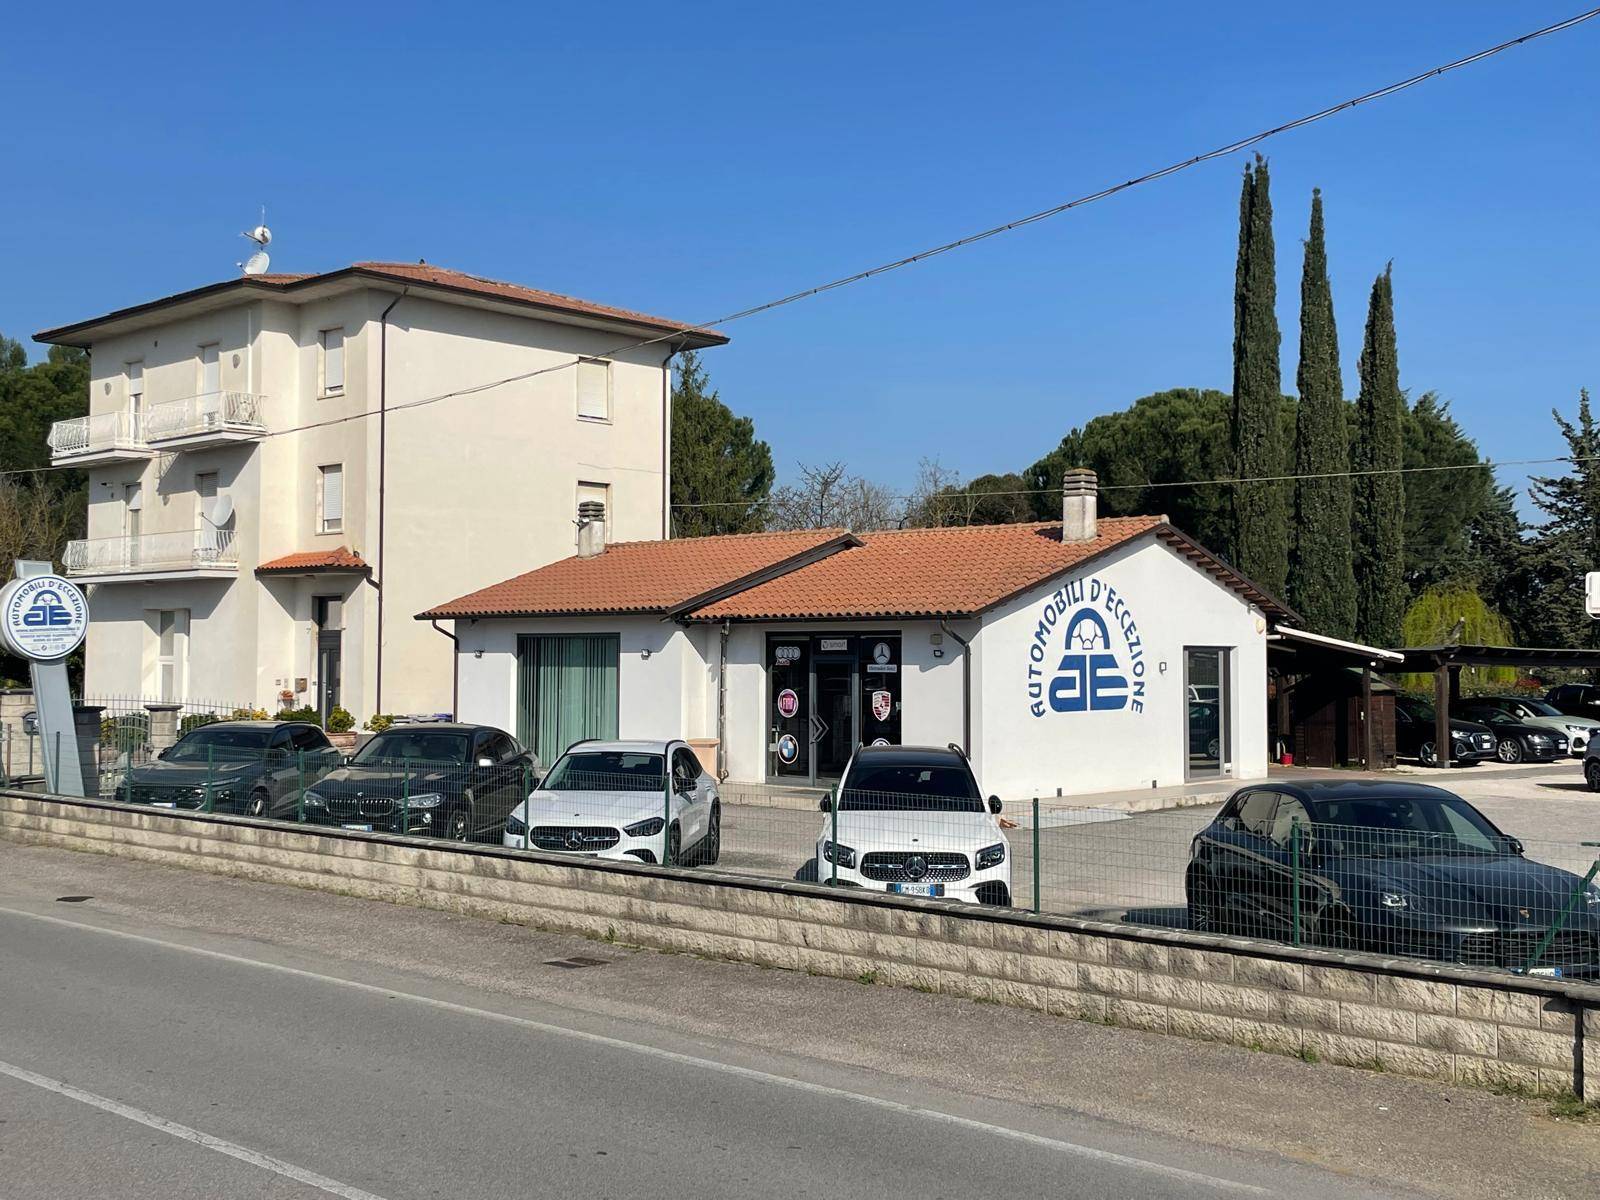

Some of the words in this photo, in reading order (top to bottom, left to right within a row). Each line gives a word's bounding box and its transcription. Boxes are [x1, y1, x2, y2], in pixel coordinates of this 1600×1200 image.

[12, 581, 46, 626] AUTOMOBILI
[48, 581, 82, 624] D'ECCEZIONE
[1028, 578, 1084, 718] AUTOMOBILI
[1090, 578, 1145, 714] D'ECCEZIONE
